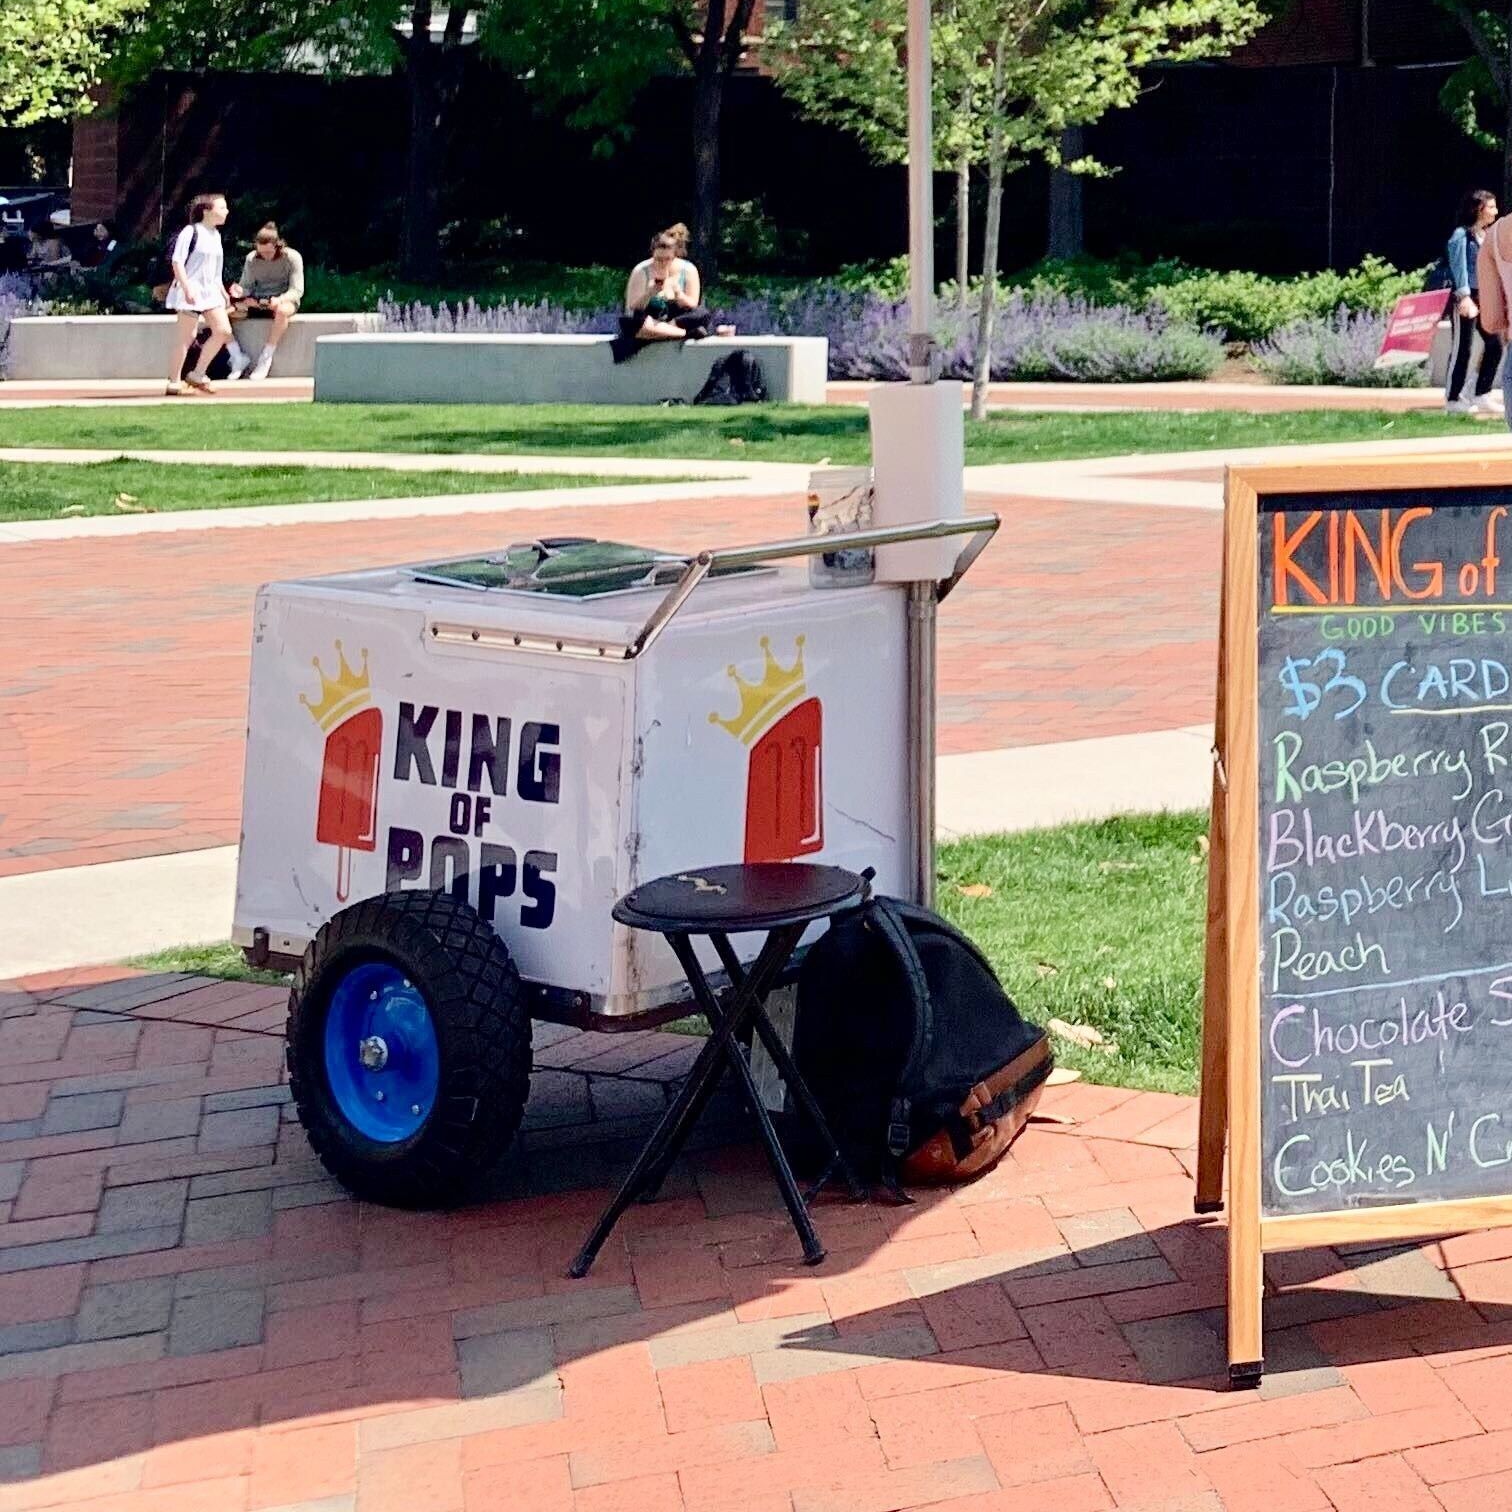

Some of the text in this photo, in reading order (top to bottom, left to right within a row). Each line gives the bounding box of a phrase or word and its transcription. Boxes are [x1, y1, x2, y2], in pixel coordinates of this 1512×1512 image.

[1273, 508, 1443, 604] KING
[1460, 507, 1508, 597] of
[1321, 614, 1395, 640] GOOD
[1419, 610, 1506, 636] VIBES
[1279, 647, 1367, 720] $3
[1381, 658, 1509, 709] CARD
[393, 701, 561, 804] KING
[1273, 731, 1472, 803] Raspberry
[450, 792, 491, 837] OF
[1267, 809, 1466, 873] Blackberry
[386, 826, 558, 929] POPS
[1268, 871, 1464, 933] Raspberry
[1272, 927, 1391, 993] Peach
[1269, 990, 1473, 1068] Chocolate
[1272, 1058, 1410, 1122] Thai Tea
[1274, 1128, 1416, 1196] Cookies
